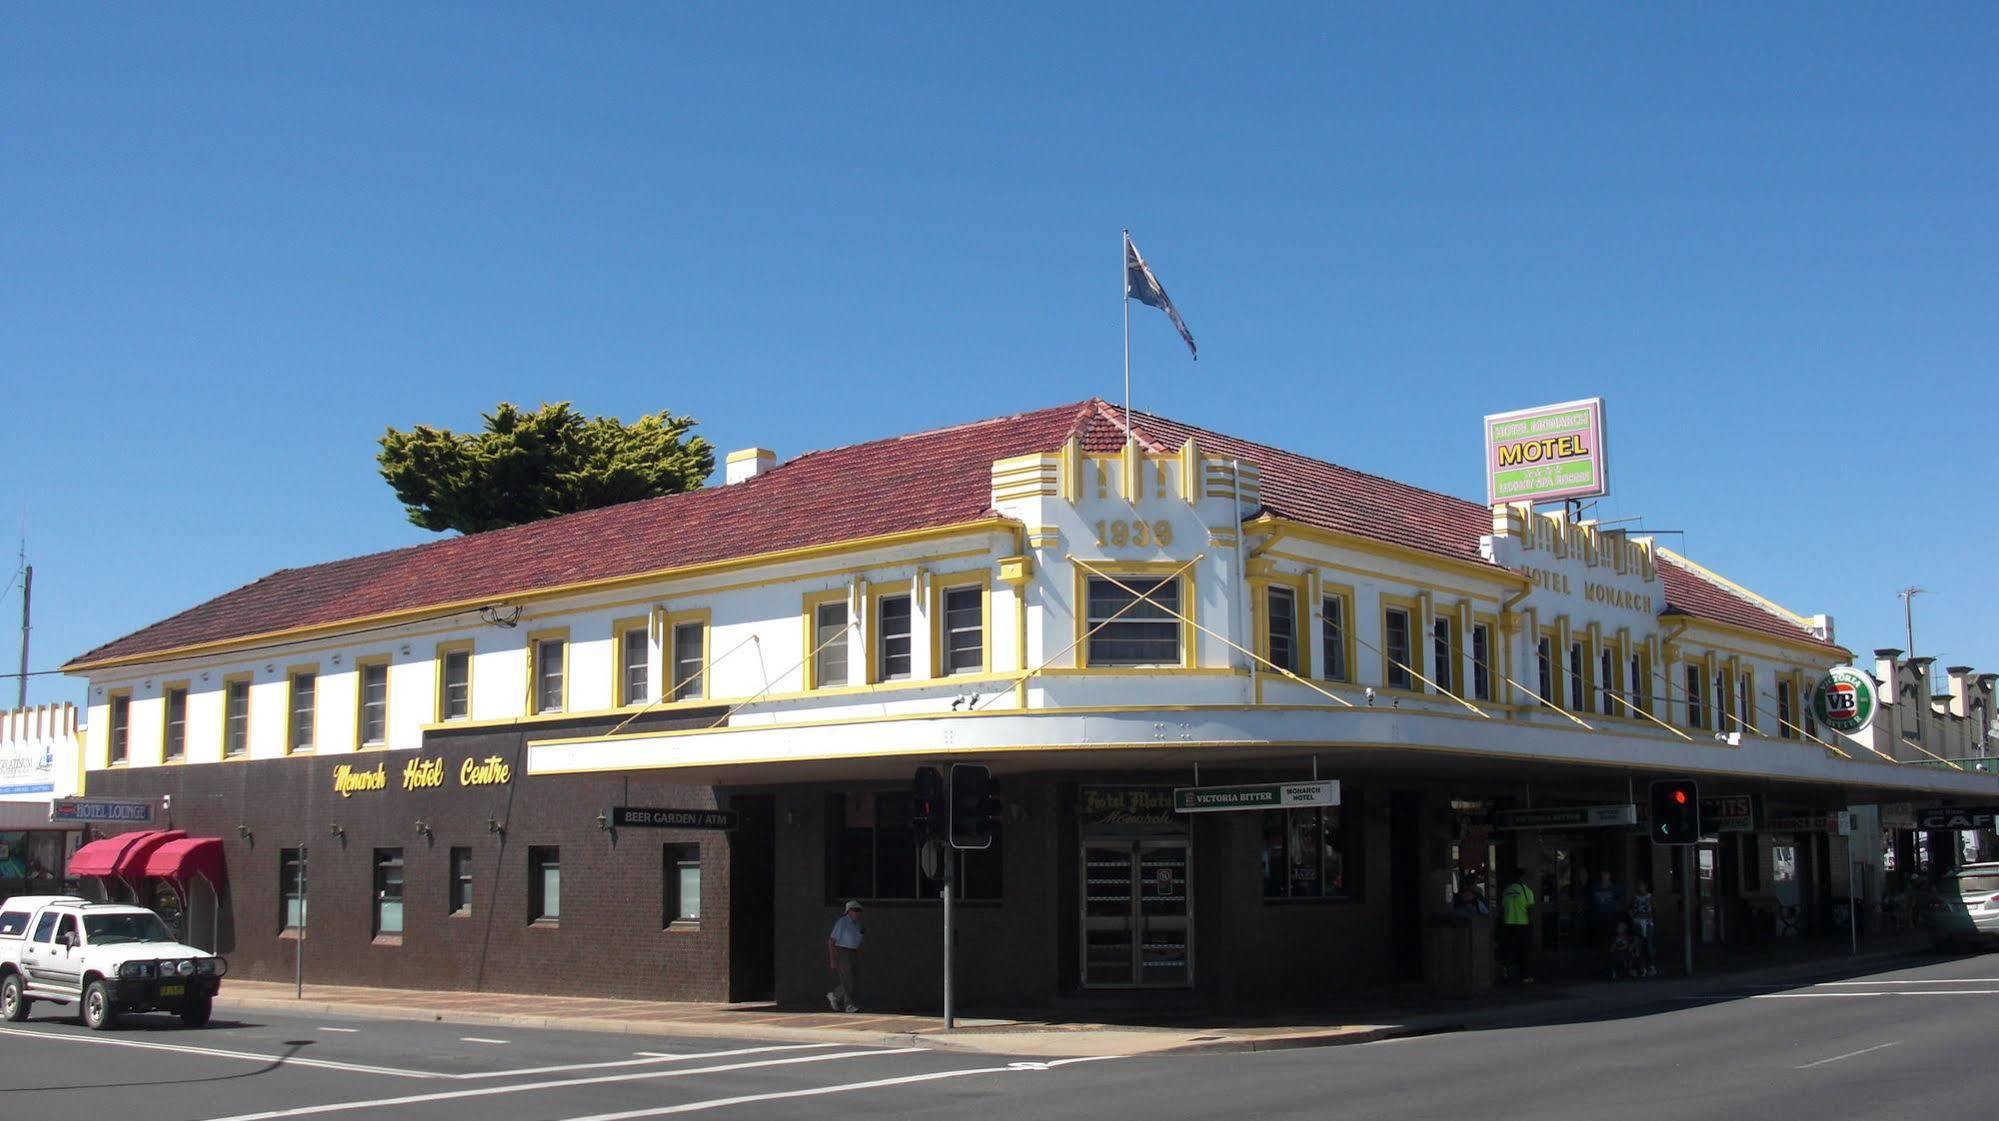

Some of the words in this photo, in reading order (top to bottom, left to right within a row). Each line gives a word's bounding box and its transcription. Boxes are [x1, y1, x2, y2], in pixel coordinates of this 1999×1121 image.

[1498, 434, 1588, 467] MOTEL
[1094, 519, 1173, 548] 1939
[1584, 580, 1652, 614] MONARCH
[1827, 693, 1855, 709] VB
[333, 762, 386, 798] Monarch
[403, 756, 444, 791] Hotel
[460, 755, 511, 786] Centre
[1196, 793, 1238, 803] VICTORIA
[1240, 791, 1273, 802] BITTER
[1286, 786, 1321, 795] MONARCH
[1293, 793, 1315, 801] HOTEL
[76, 804, 108, 818] HOTEL
[109, 804, 145, 819] LOUNGE
[624, 811, 651, 823] BEER
[653, 812, 697, 824] GARDEN
[704, 815, 727, 825] ATM
